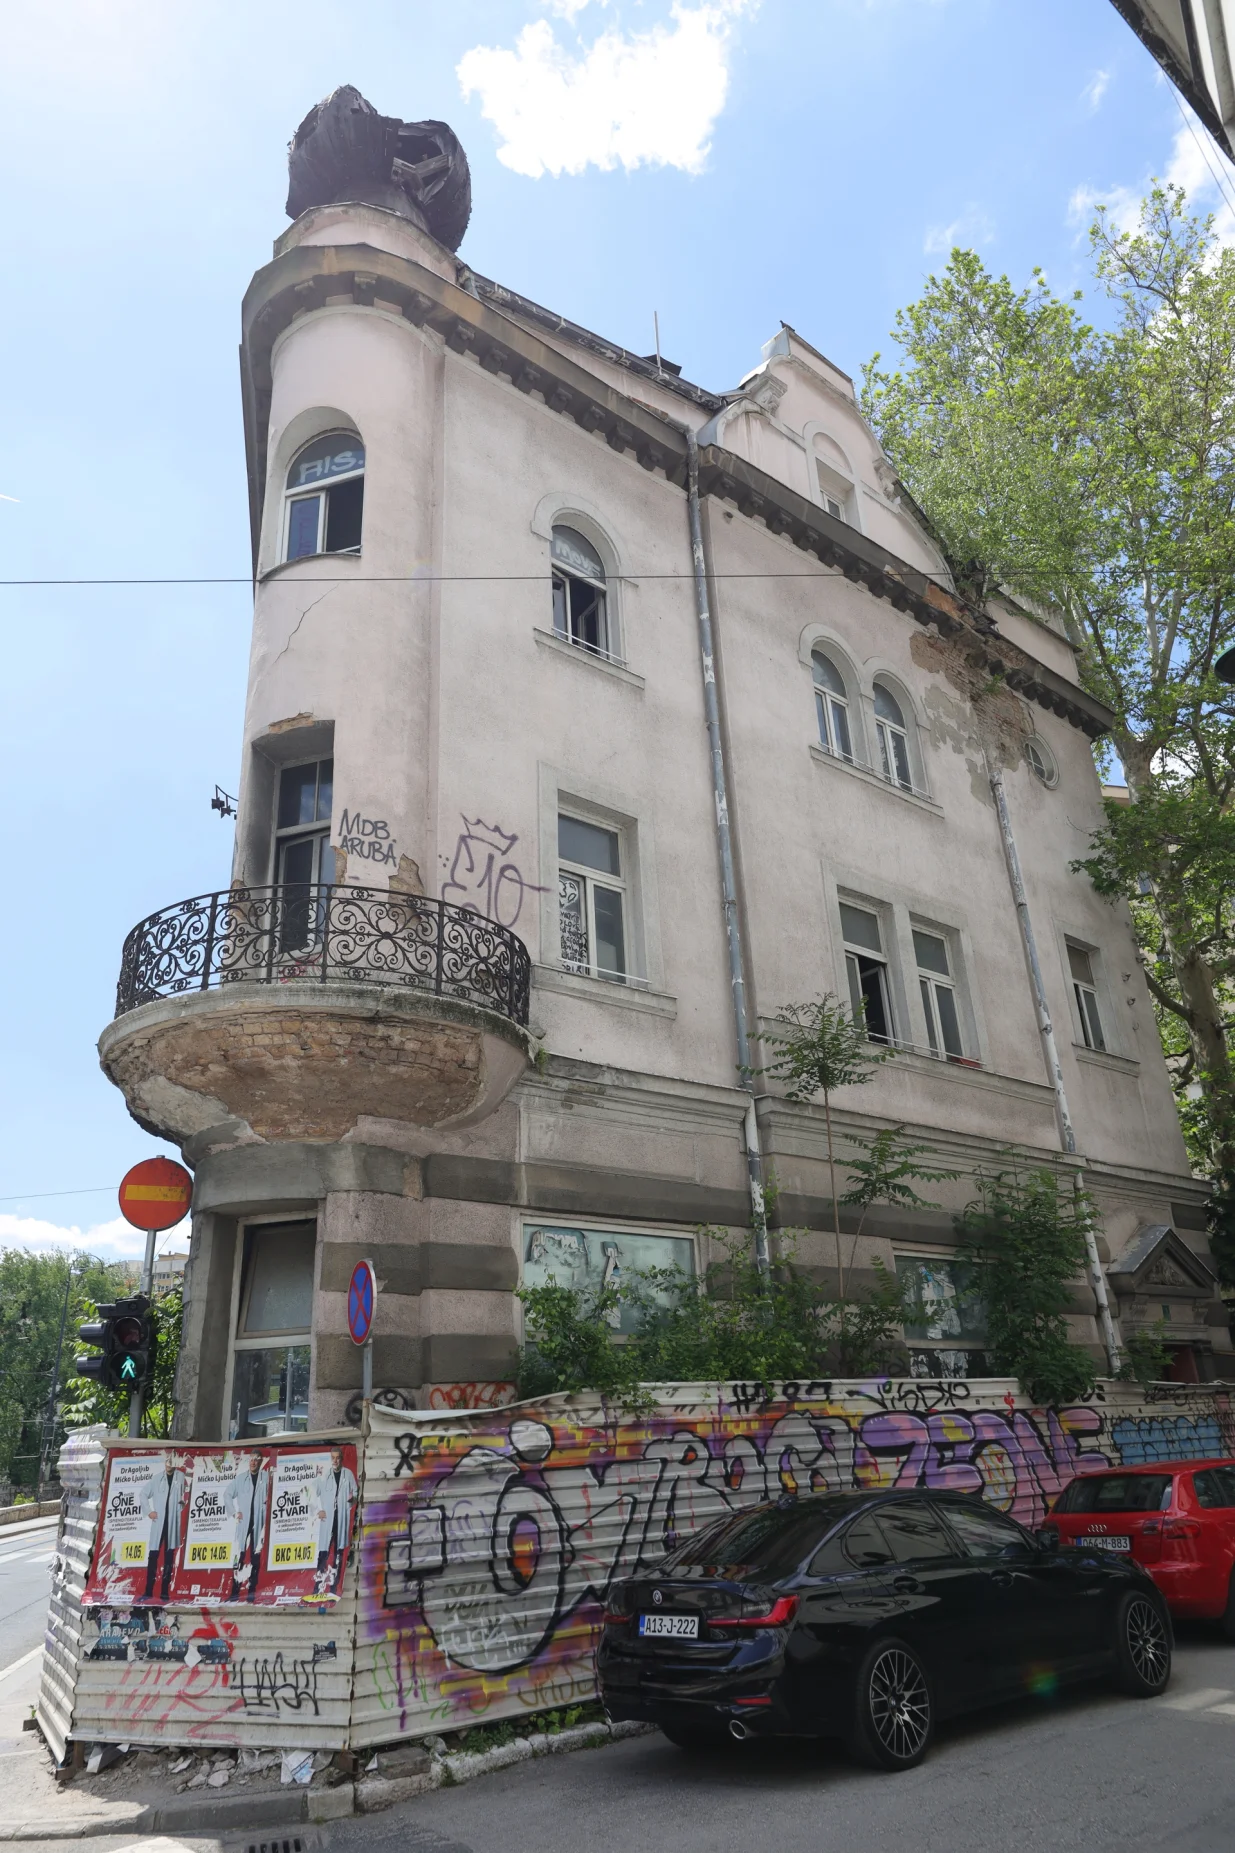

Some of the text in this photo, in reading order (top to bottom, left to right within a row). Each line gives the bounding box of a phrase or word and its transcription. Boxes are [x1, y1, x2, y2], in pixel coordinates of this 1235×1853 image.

[340, 836, 398, 868] ARUBA
[111, 1493, 134, 1508] ONE
[195, 1493, 218, 1508] ONE
[276, 1493, 300, 1508] ONE
[107, 1506, 141, 1518] STVARI
[190, 1506, 225, 1518] STVARI
[272, 1505, 308, 1519] STVARI
[125, 1545, 142, 1559] 14.05.
[210, 1546, 228, 1559] 14.05.
[275, 1546, 312, 1562] BKC 14.05.
[100, 1627, 140, 1637] ARAJEVO
[645, 1617, 696, 1635] A13-J-222
